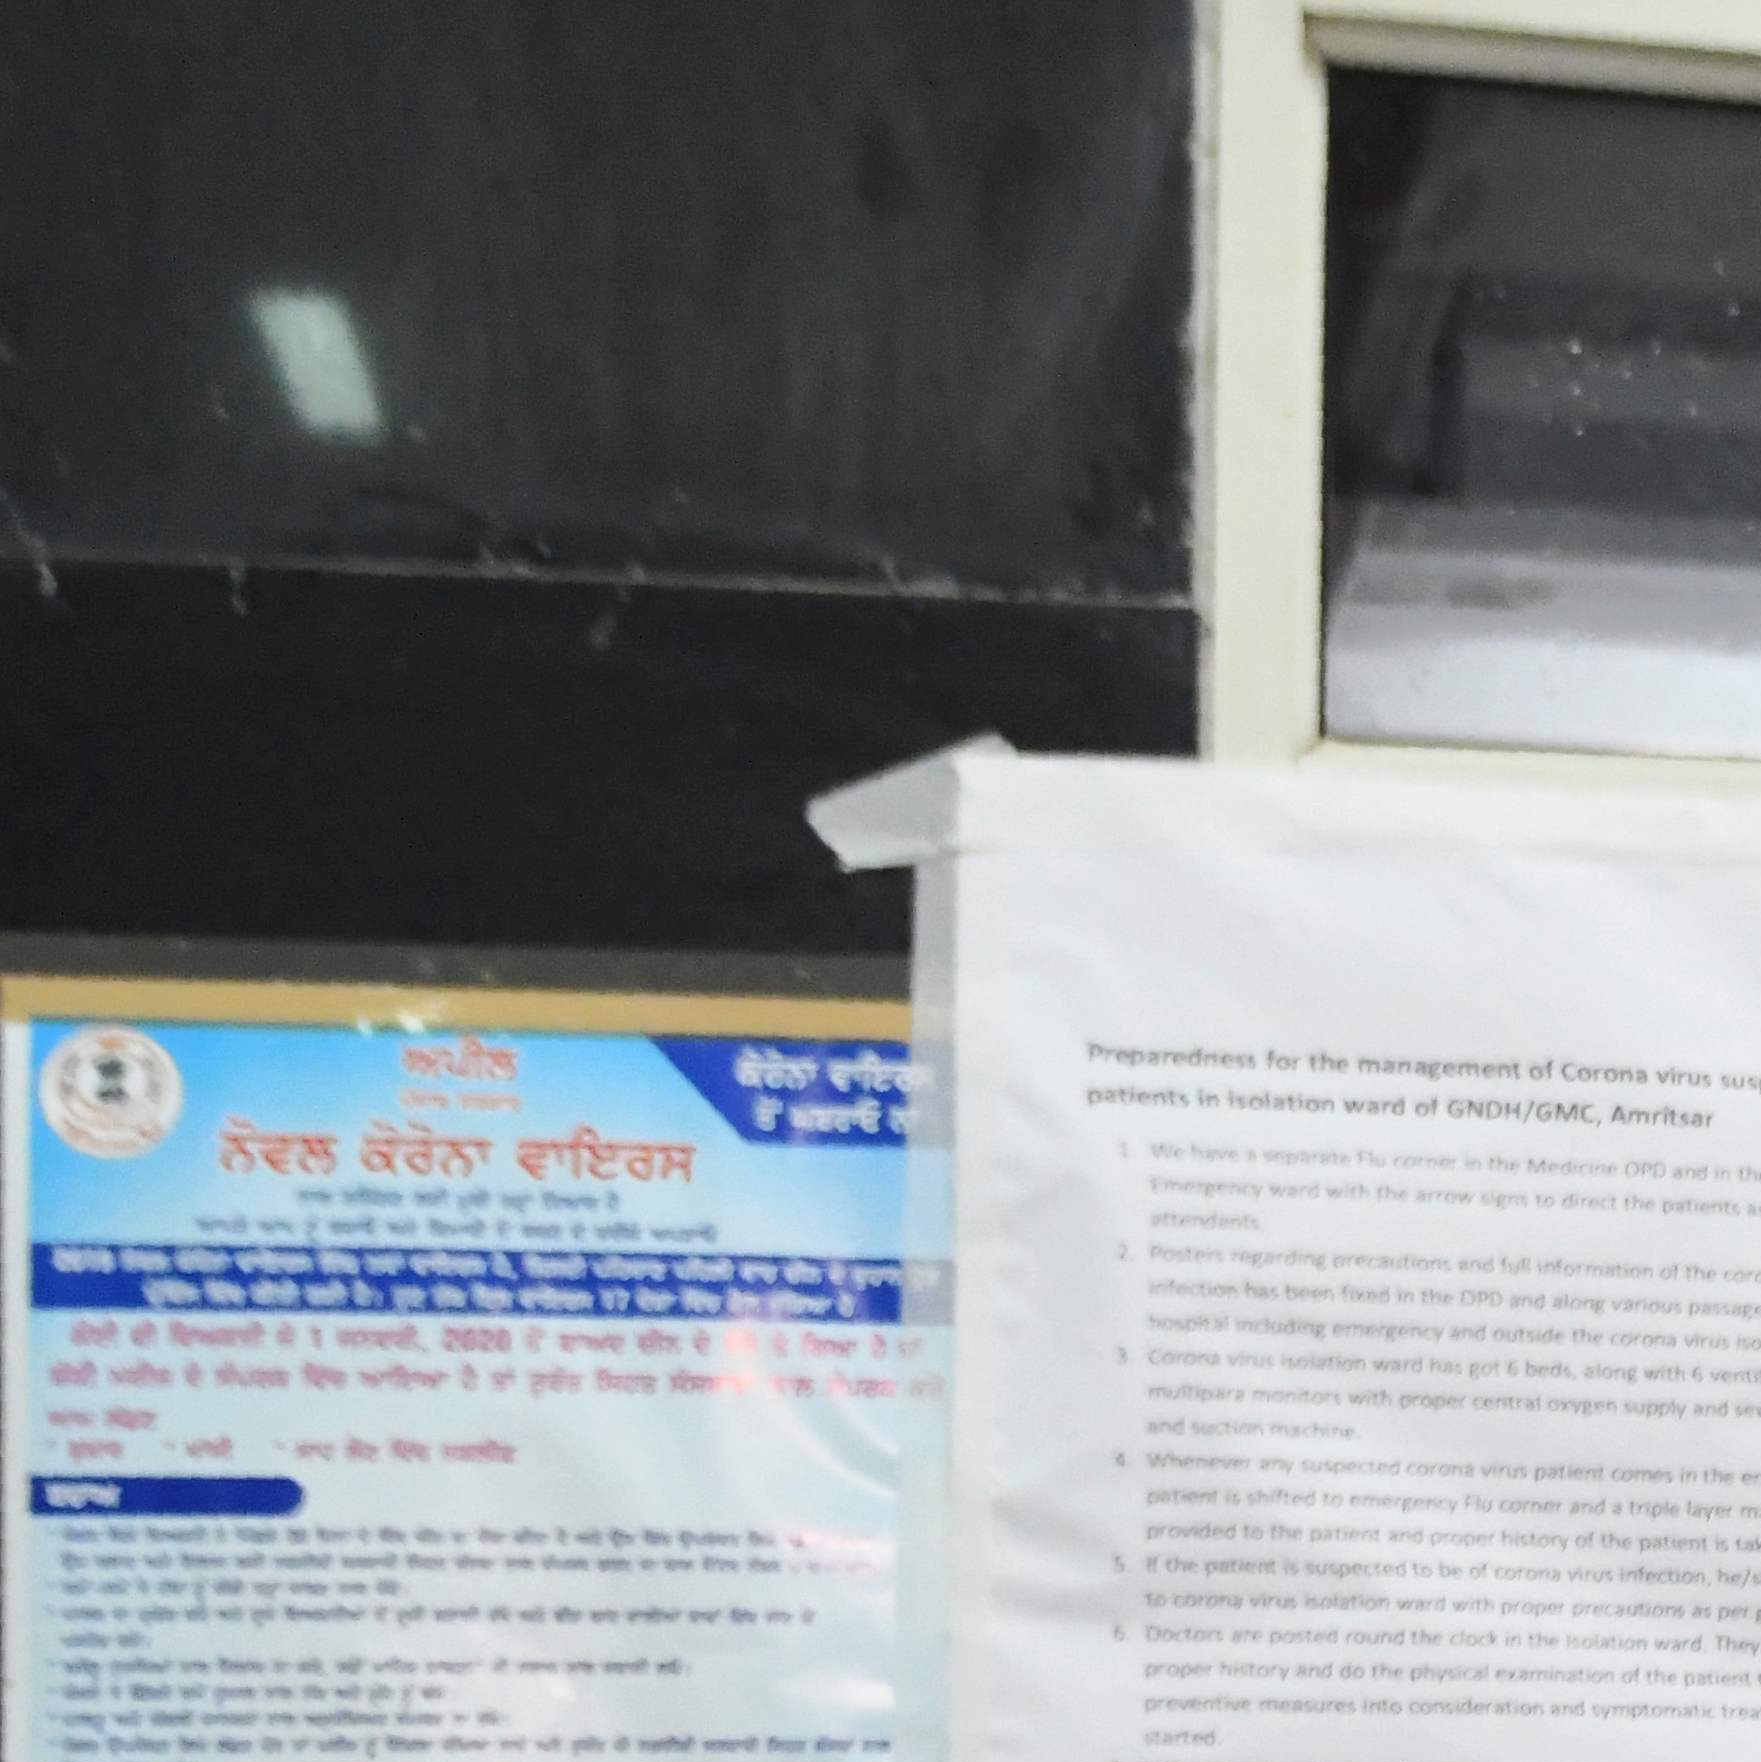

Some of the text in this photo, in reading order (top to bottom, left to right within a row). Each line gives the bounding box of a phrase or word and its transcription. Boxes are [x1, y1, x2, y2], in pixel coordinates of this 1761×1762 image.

[1086, 1042, 1257, 1072] Preparedness
[1265, 1048, 1300, 1070] for
[1308, 1050, 1349, 1071] the
[1357, 1052, 1520, 1083] management
[1528, 1059, 1554, 1080] of
[1560, 1061, 1648, 1085] Corona
[1655, 1065, 1712, 1088] virus
[1085, 1083, 1190, 1111] patients
[1196, 1087, 1220, 1108] in
[1226, 1088, 1335, 1112] isolation
[1343, 1092, 1406, 1115] ward
[1414, 1095, 1439, 1116] of
[1610, 1103, 1713, 1127] Amritsar
[219, 1115, 697, 1183] ਨੋਵਲ ਕੋਰੋਨਾ ਵਾਇਰਸ
[1148, 1242, 1224, 1263] Posters
[1229, 1245, 1327, 1270] regarding
[1331, 1249, 1452, 1275] precautions
[1457, 1253, 1495, 1273] and
[1498, 1255, 1531, 1274] full
[1536, 1256, 1654, 1279] information
[1658, 1261, 1681, 1280] of
[1684, 1262, 1717, 1281] the
[1145, 1450, 1251, 1471] Whenever
[1258, 1456, 1294, 1476] any
[1300, 1454, 1401, 1479] suspected
[1405, 1460, 1476, 1477] corona
[1479, 1459, 1528, 1479] virus
[1533, 1461, 1605, 1485] patient
[1610, 1466, 1674, 1483] comes
[1679, 1465, 1698, 1484] in
[1702, 1466, 1735, 1485] the
[1144, 1623, 1223, 1642] Doctors
[1230, 1627, 1263, 1643] are
[1268, 1625, 1339, 1648] posted
[1345, 1626, 1406, 1645] round
[1410, 1628, 1443, 1646] the
[1448, 1628, 1498, 1647] clock
[1504, 1629, 1522, 1648] in
[1527, 1630, 1560, 1648] the
[1715, 1634, 1760, 1657] They
